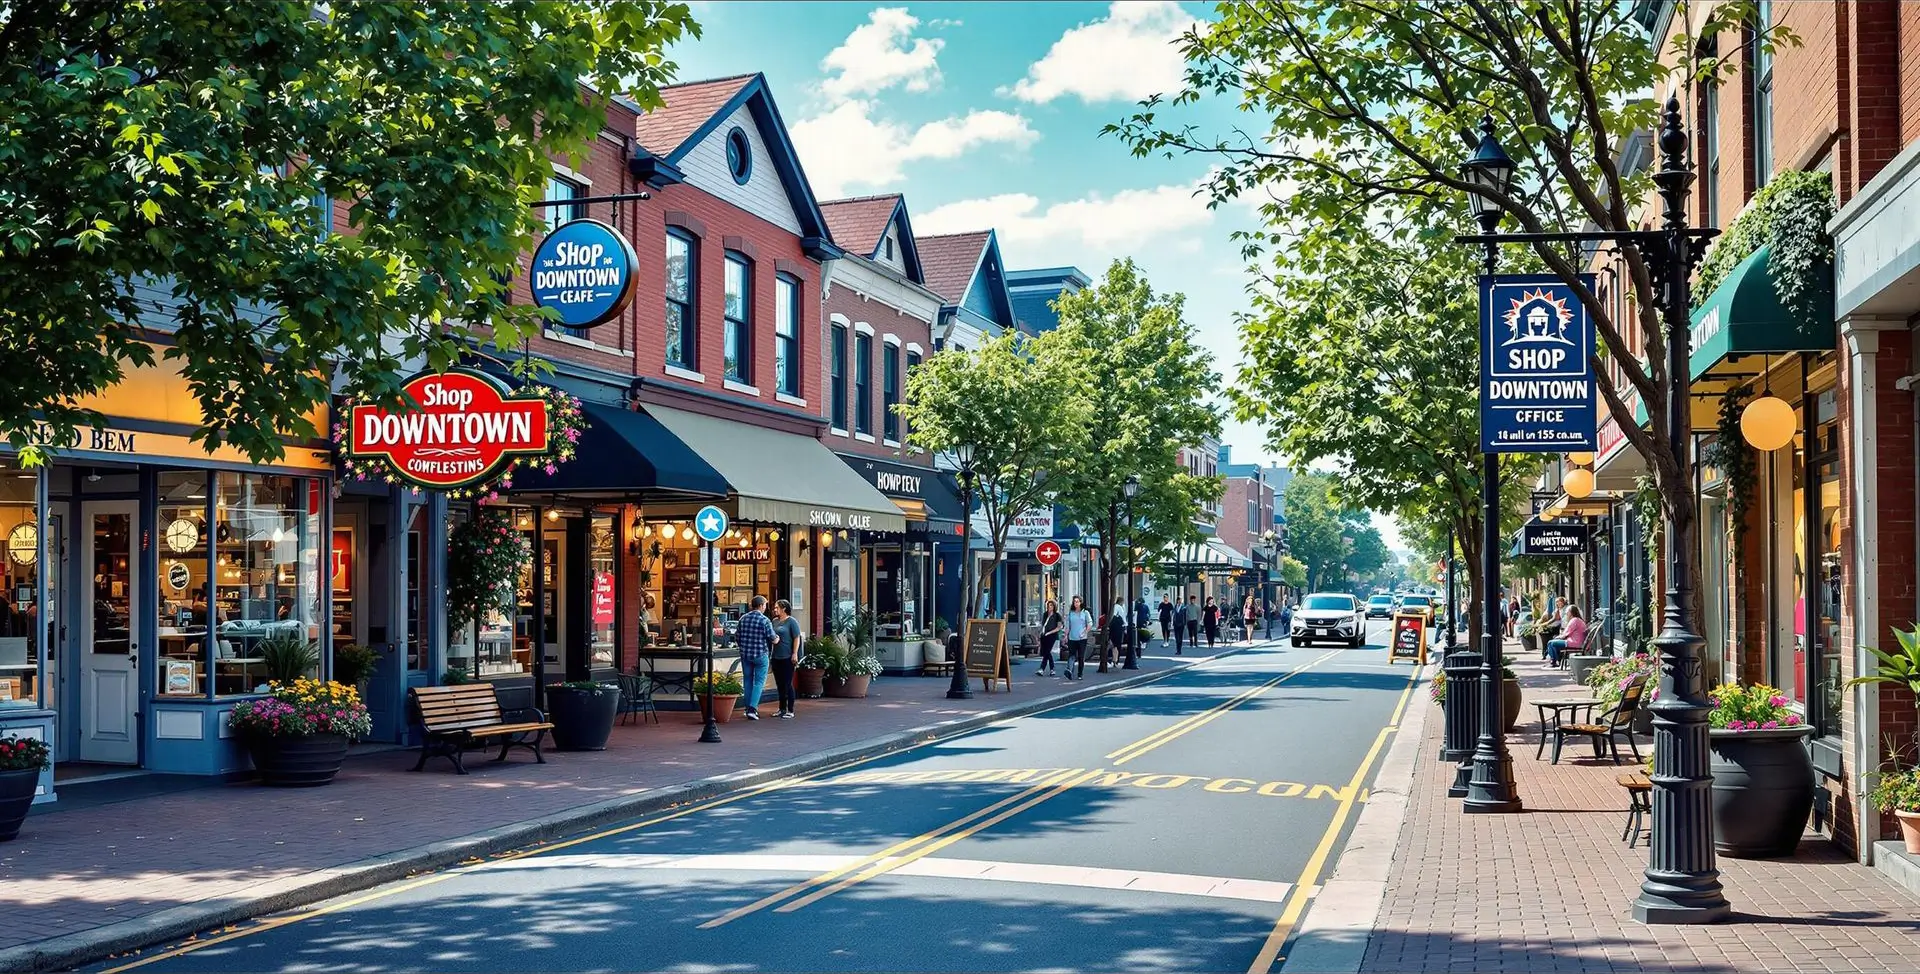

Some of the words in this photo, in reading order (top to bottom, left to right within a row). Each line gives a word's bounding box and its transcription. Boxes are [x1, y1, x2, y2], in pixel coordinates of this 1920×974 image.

[555, 241, 604, 267] SHOP
[536, 267, 620, 289] DOWNTOWN
[560, 290, 594, 304] CEAFE
[1508, 348, 1566, 370] SHOP
[422, 383, 473, 411] Shop
[1489, 380, 1588, 400] DOWNTOWN
[362, 411, 531, 445] DOWNTOWN
[1537, 429, 1555, 440] 155
